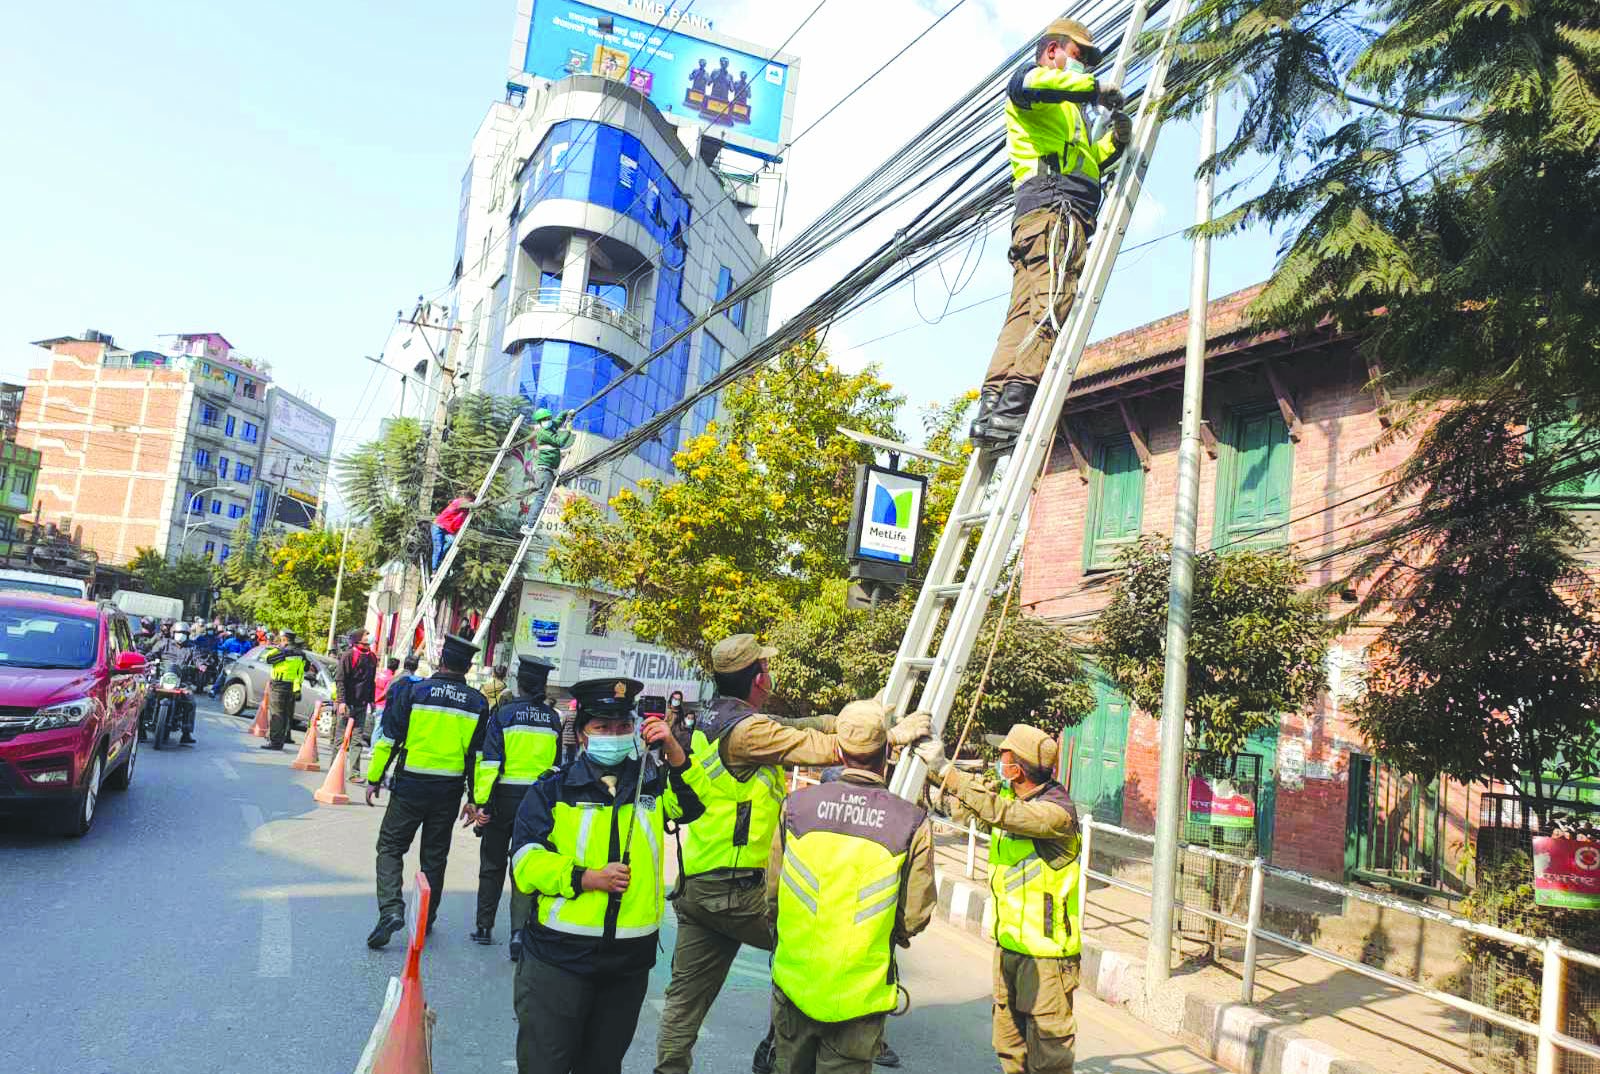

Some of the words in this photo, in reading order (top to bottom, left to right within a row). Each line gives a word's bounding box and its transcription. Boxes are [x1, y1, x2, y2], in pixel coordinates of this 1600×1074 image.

[632, 0, 666, 17] NMB
[669, 7, 714, 31] BANK
[868, 526, 907, 543] MetLife
[430, 687, 445, 698] CITY
[445, 688, 468, 703] POLICE
[516, 711, 529, 722] CITY
[529, 711, 551, 723] POLICE
[841, 793, 868, 806] LMC
[817, 800, 843, 821] CITY
[843, 804, 886, 829] POLICE
